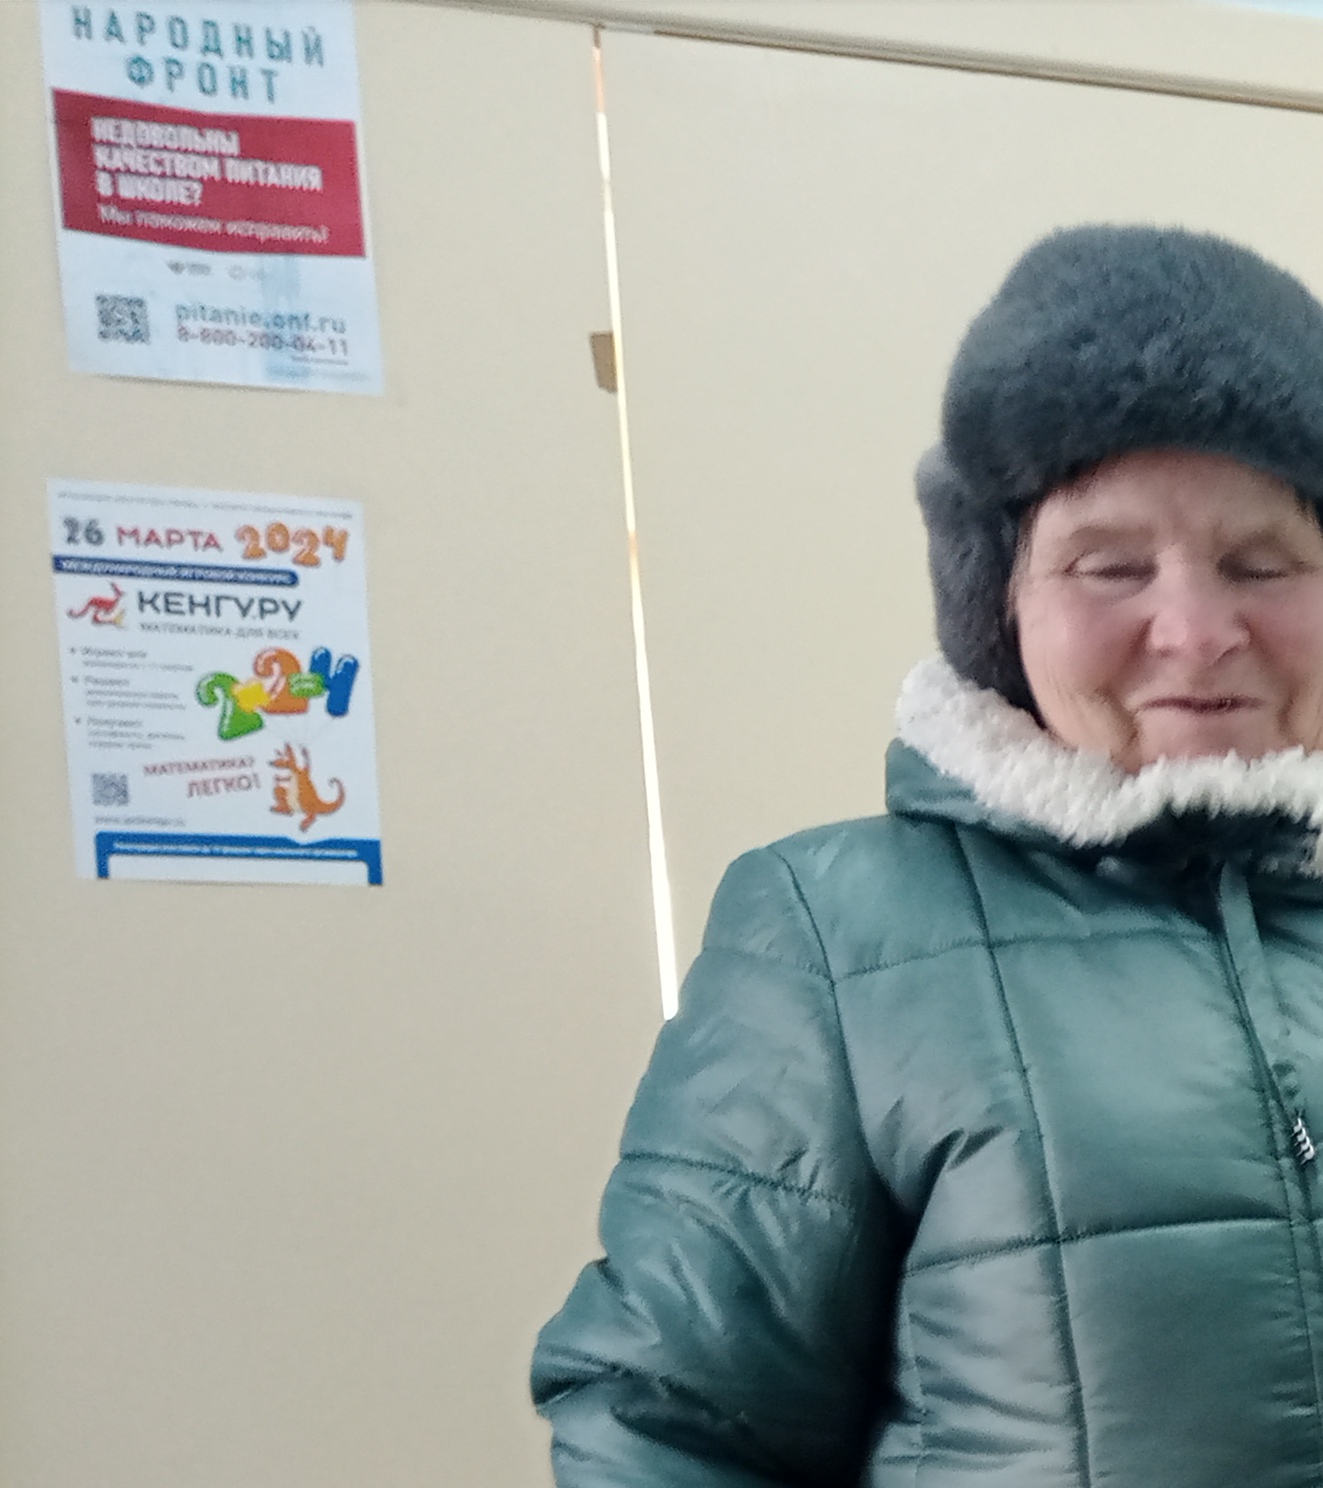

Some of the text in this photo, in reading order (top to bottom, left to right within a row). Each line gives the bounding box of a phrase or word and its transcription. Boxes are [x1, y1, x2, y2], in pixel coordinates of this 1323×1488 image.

[71, 5, 324, 67] НАРОДНЫЙ
[126, 54, 279, 105] ФРОНТ
[93, 144, 324, 191] КАЧЕСТВОМ ПИТАНИЯ
[96, 170, 114, 197] В
[63, 517, 349, 568] 26 МАРТА 2024
[138, 590, 302, 622] КЕНГУРУ
[187, 771, 261, 798] ЛЕГКО!
